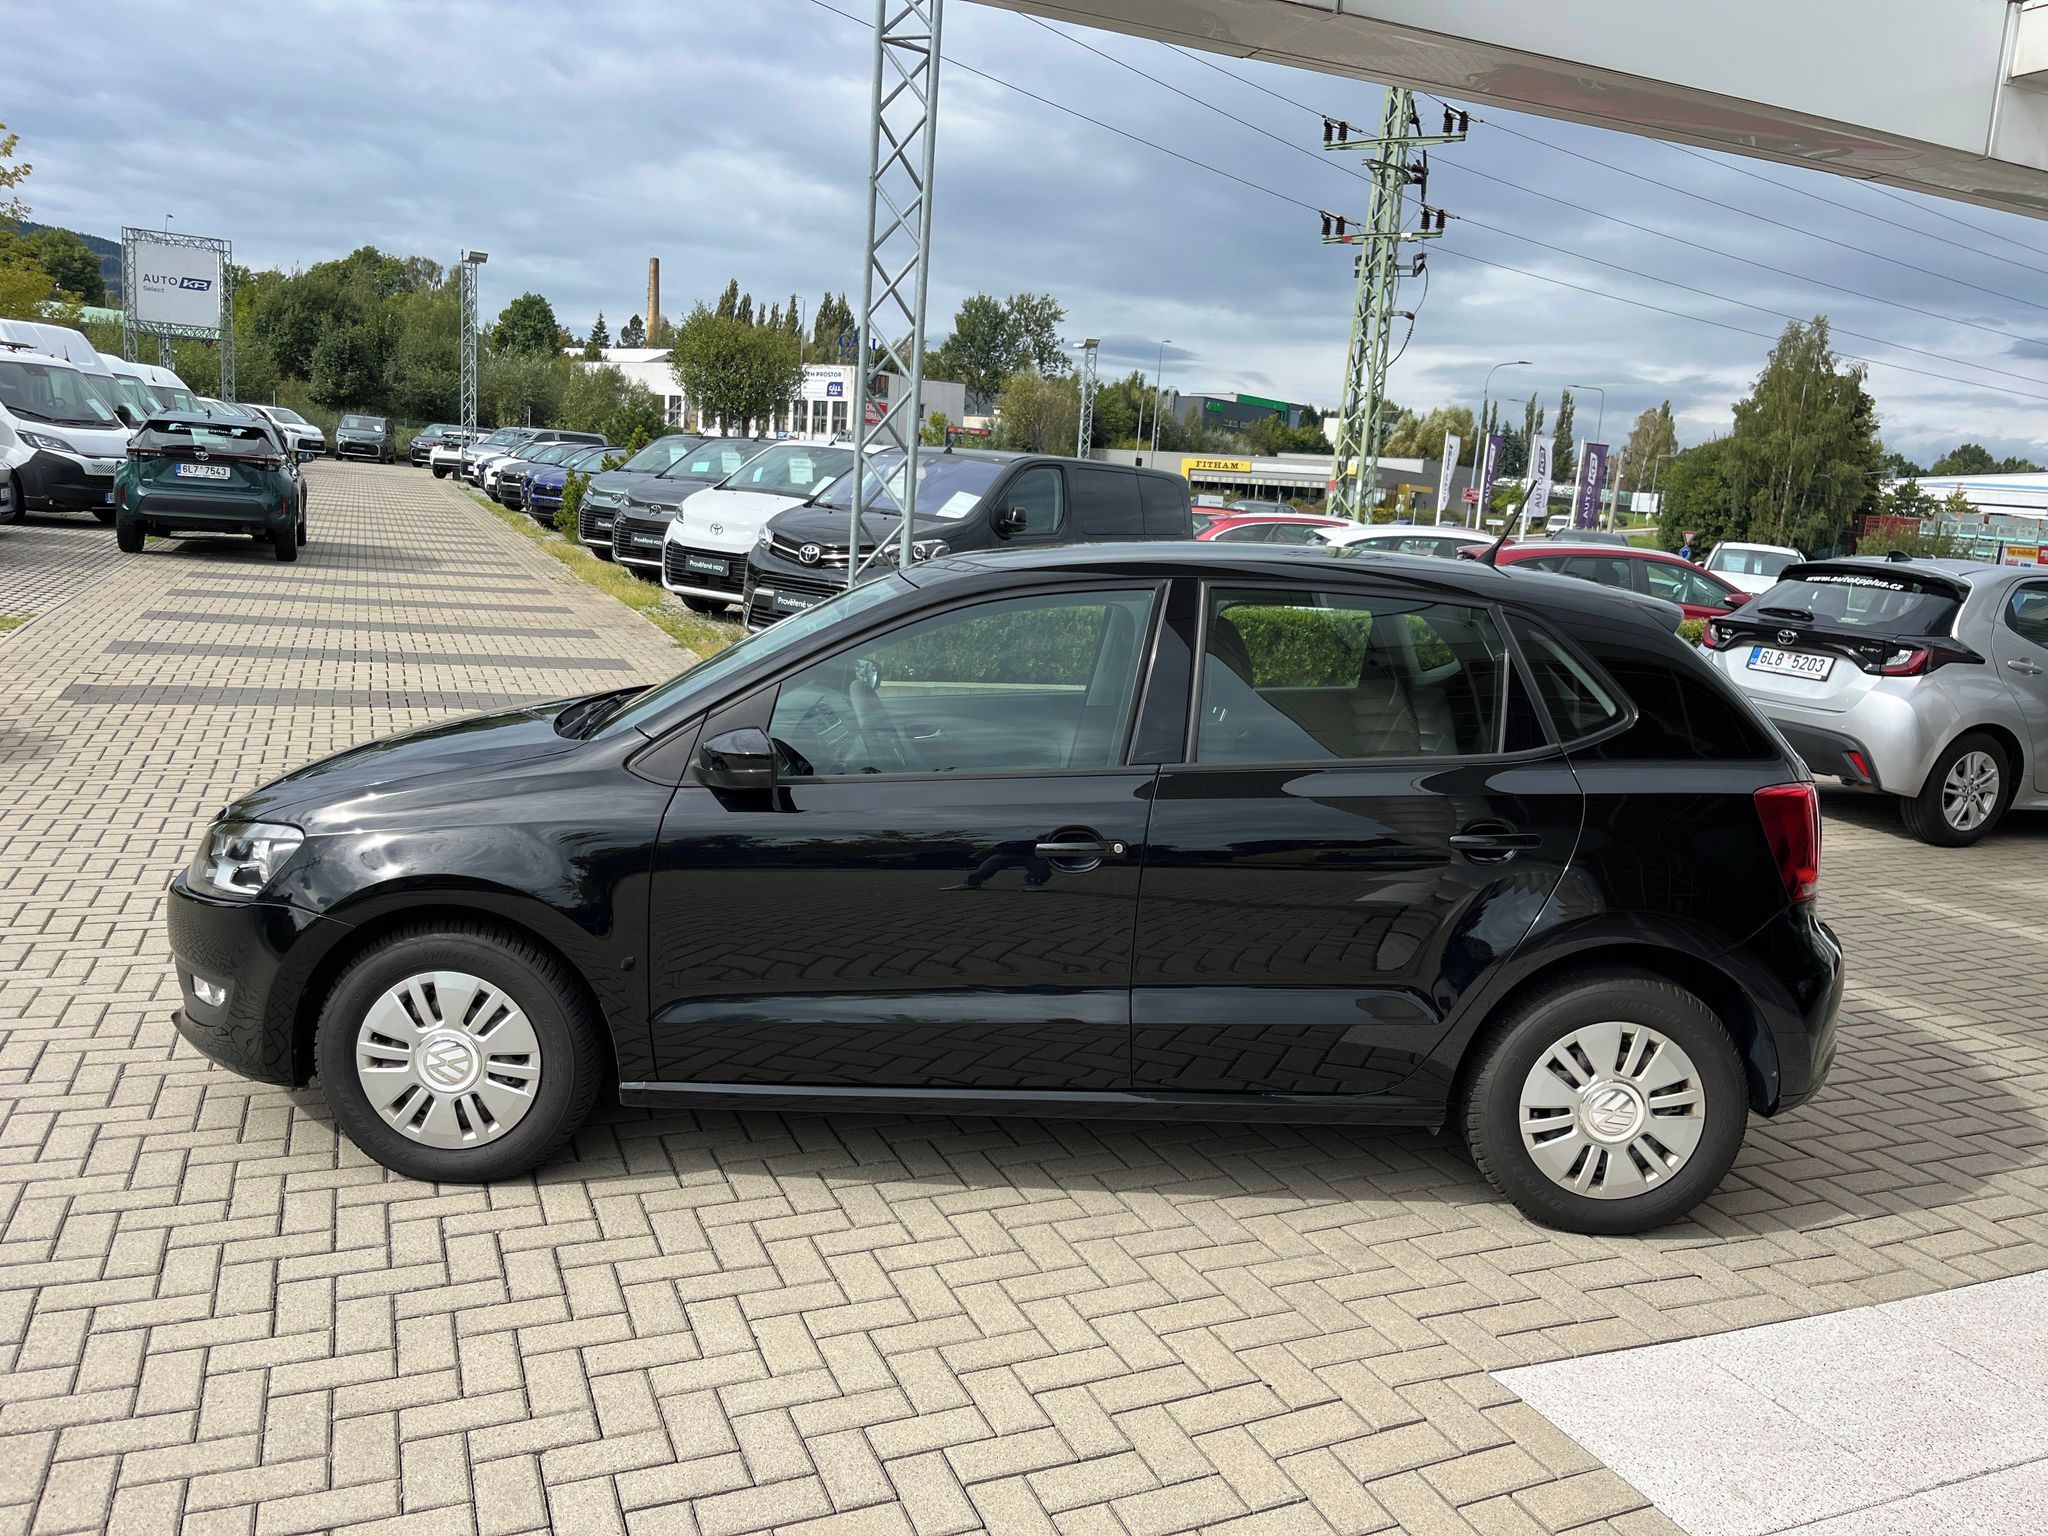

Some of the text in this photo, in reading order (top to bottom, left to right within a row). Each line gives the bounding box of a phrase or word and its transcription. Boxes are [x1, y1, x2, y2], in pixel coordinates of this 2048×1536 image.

[143, 273, 178, 286] AUTO
[143, 285, 165, 293] Select
[182, 464, 198, 474] 6L7
[205, 465, 227, 476] 7543
[1195, 460, 1240, 470] FITHAM
[1534, 475, 1544, 509] AUTO
[1582, 485, 1593, 519] AUTO
[689, 559, 725, 573] Prověřené vozy
[1805, 575, 1904, 591] www.autokpplus.cz
[777, 595, 807, 608] Prověřené
[1760, 650, 1826, 673] 6L8 5203
